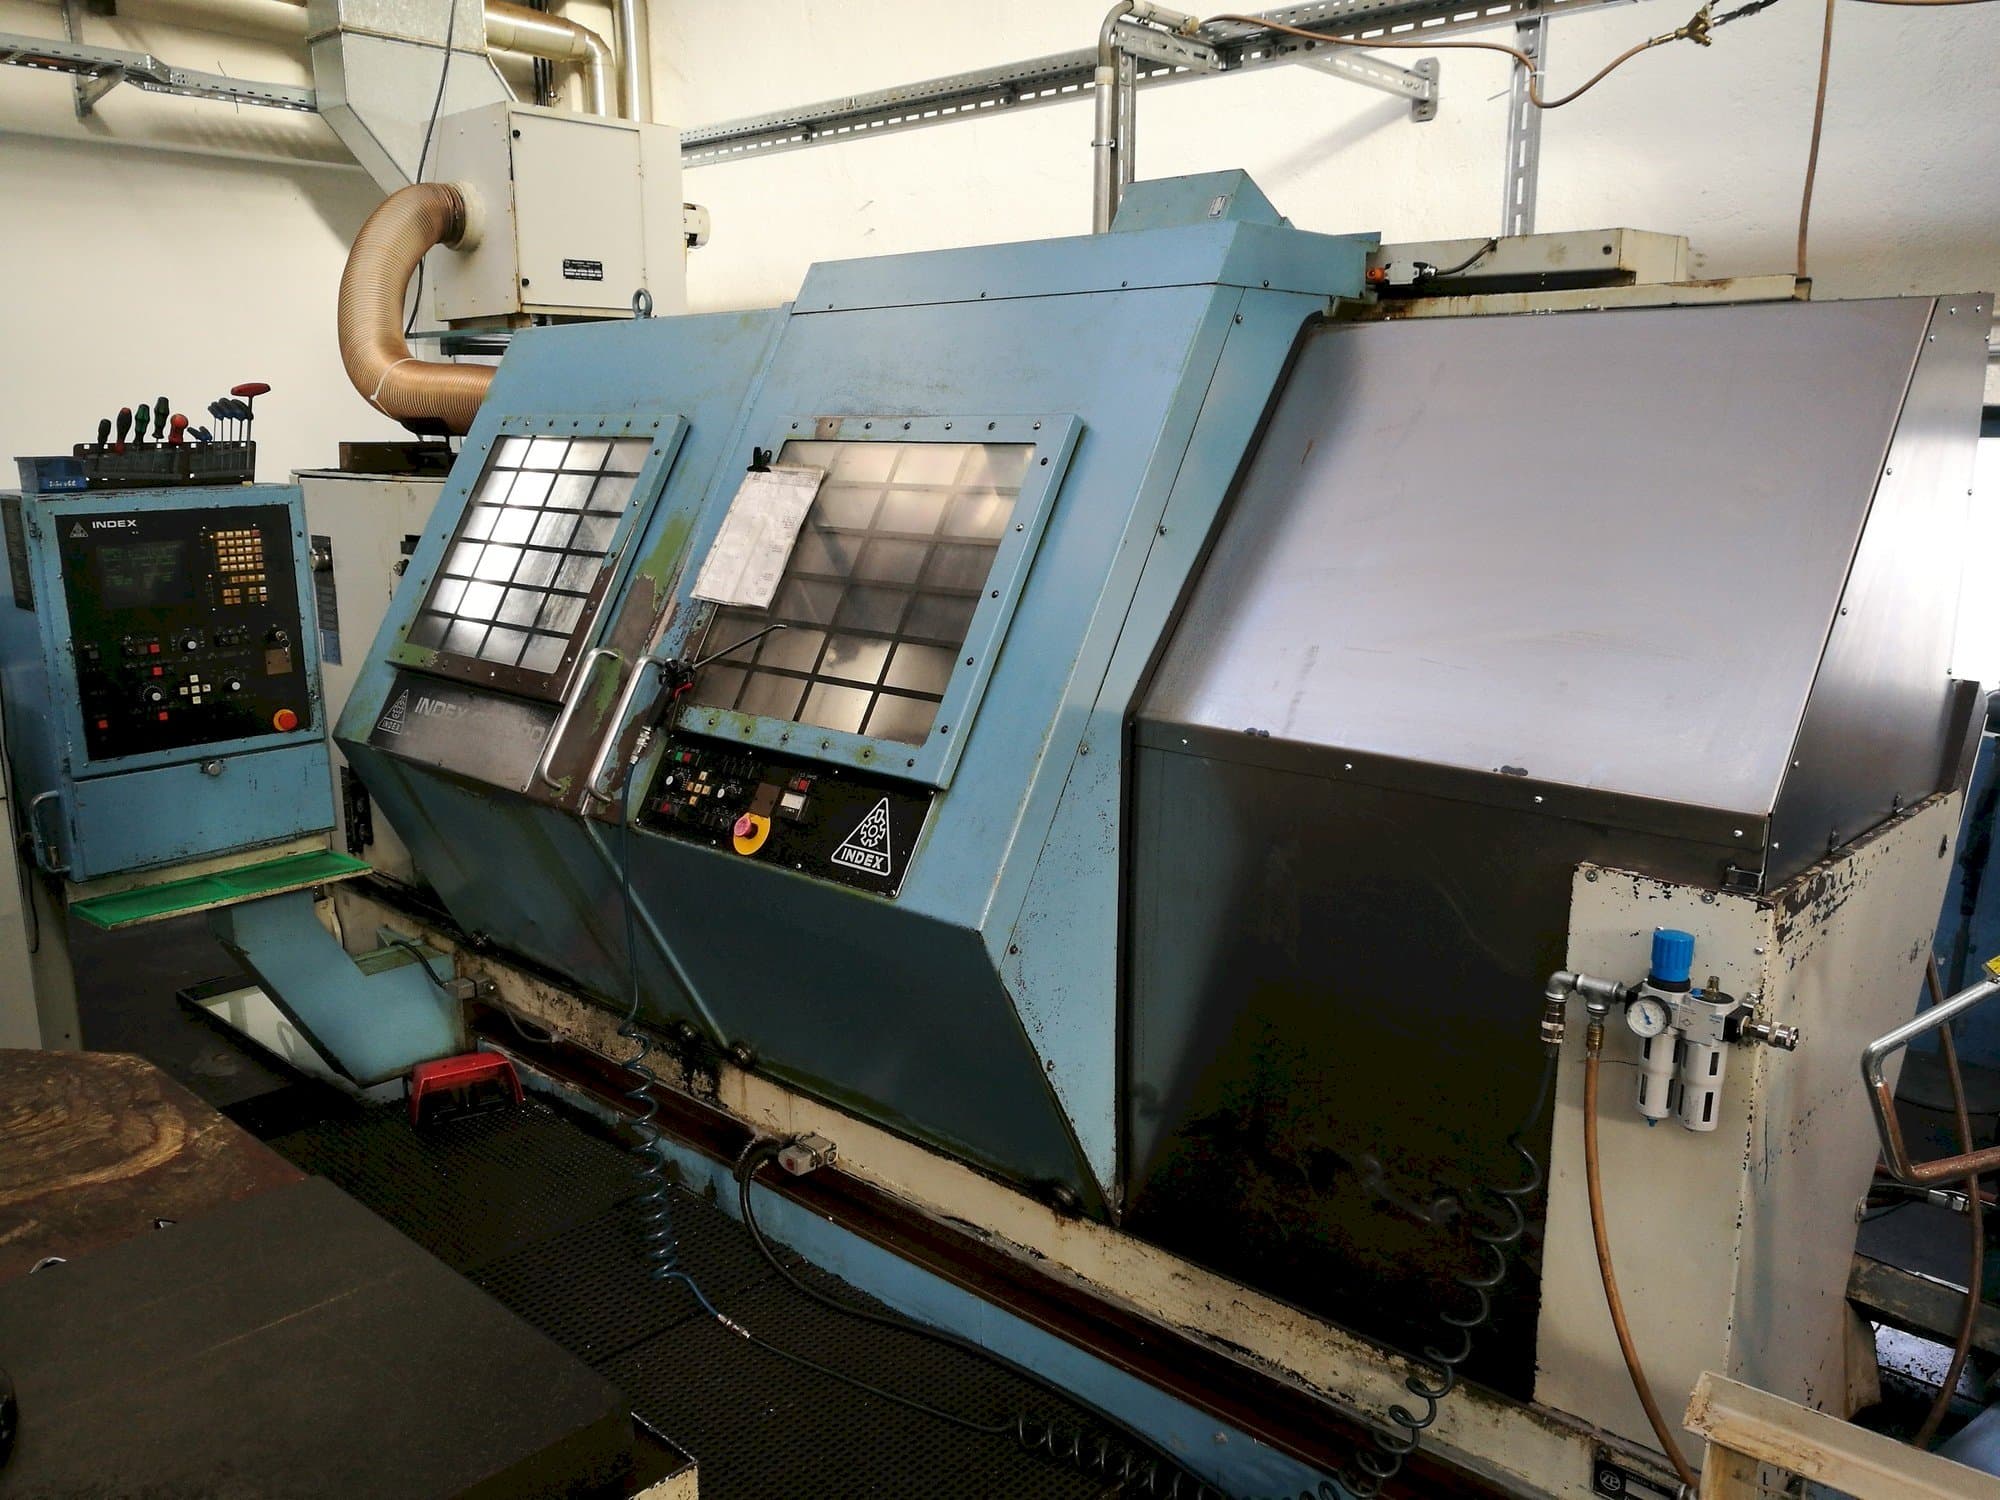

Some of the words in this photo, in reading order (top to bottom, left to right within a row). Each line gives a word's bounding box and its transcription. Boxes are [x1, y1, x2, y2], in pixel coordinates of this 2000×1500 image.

[91, 519, 137, 529] INDEX
[414, 696, 469, 720] INDEX
[840, 847, 885, 870] INDEX
